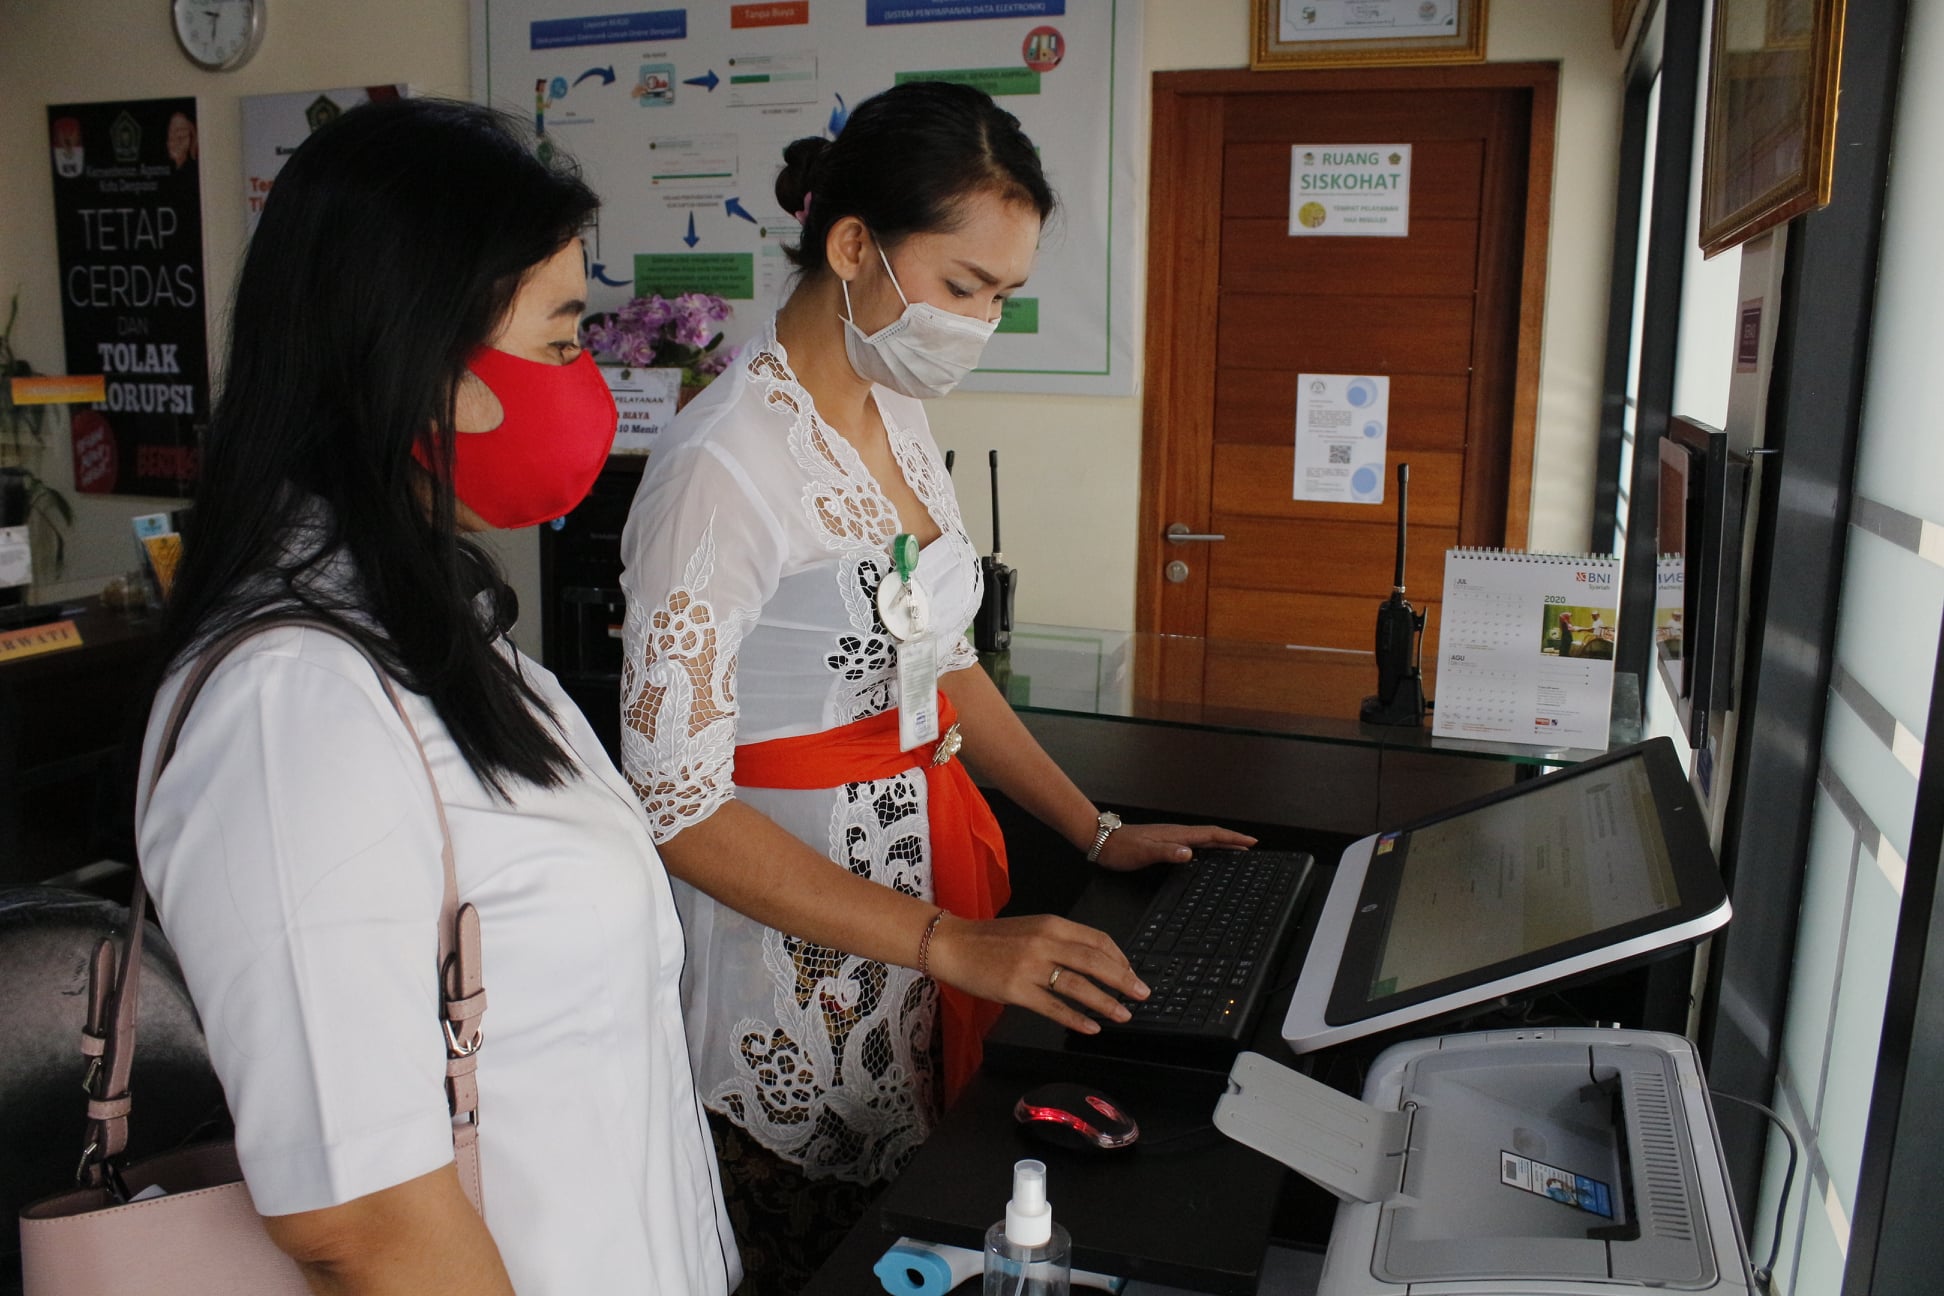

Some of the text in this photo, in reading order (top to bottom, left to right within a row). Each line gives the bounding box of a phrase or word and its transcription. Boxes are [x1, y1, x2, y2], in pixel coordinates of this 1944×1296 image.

[973, 6, 994, 15] DATA
[1322, 152, 1379, 165] RUANG
[1300, 173, 1401, 190] SISKOHAT
[77, 207, 178, 250] TETAP
[67, 264, 196, 308] CERDAS
[117, 316, 149, 336] DAN
[97, 343, 180, 373] TOLAK
[91, 382, 194, 414] ORUPSI
[615, 396, 664, 404] PELAYANAN
[623, 411, 650, 420] BIAYA
[619, 424, 659, 434] 10 Menit
[1588, 572, 1610, 583] BNI
[1544, 595, 1566, 604] 2020
